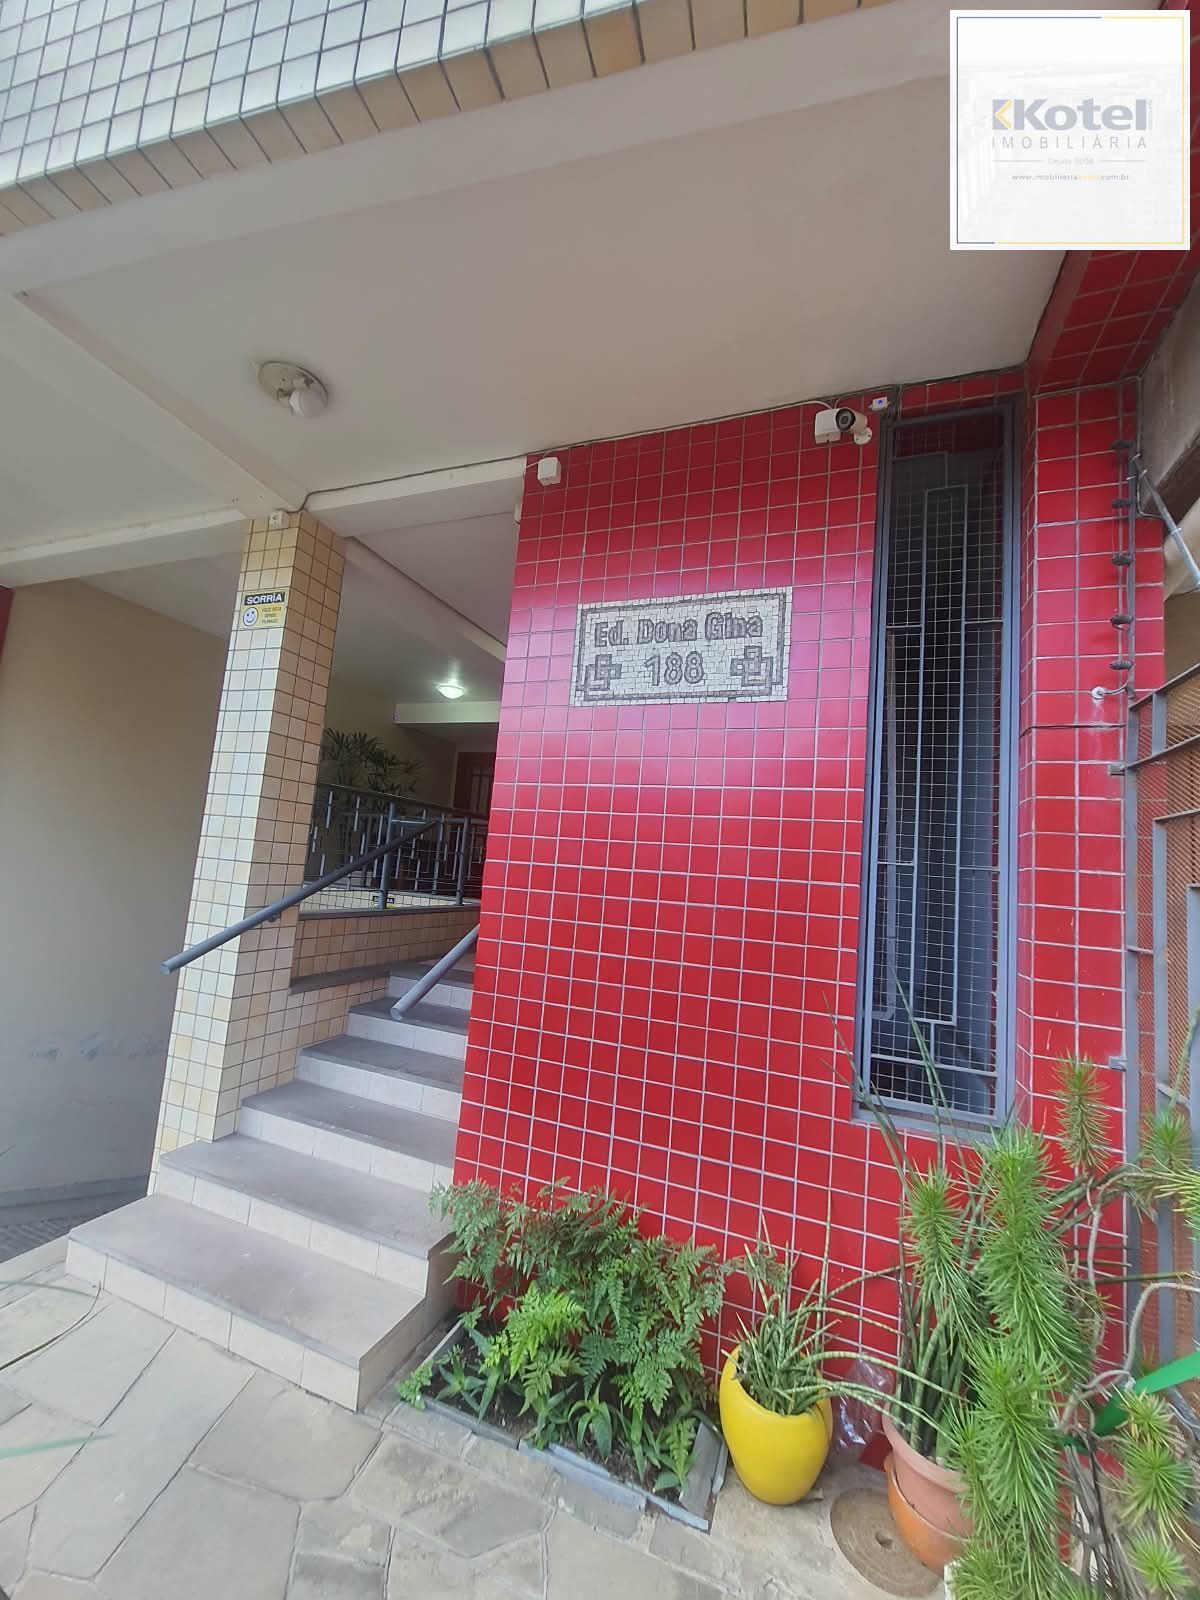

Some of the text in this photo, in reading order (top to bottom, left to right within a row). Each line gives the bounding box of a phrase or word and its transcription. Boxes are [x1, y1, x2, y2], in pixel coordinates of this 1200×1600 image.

[594, 621, 629, 647] Ed.
[637, 618, 698, 644] Dona
[644, 650, 705, 686] 188
